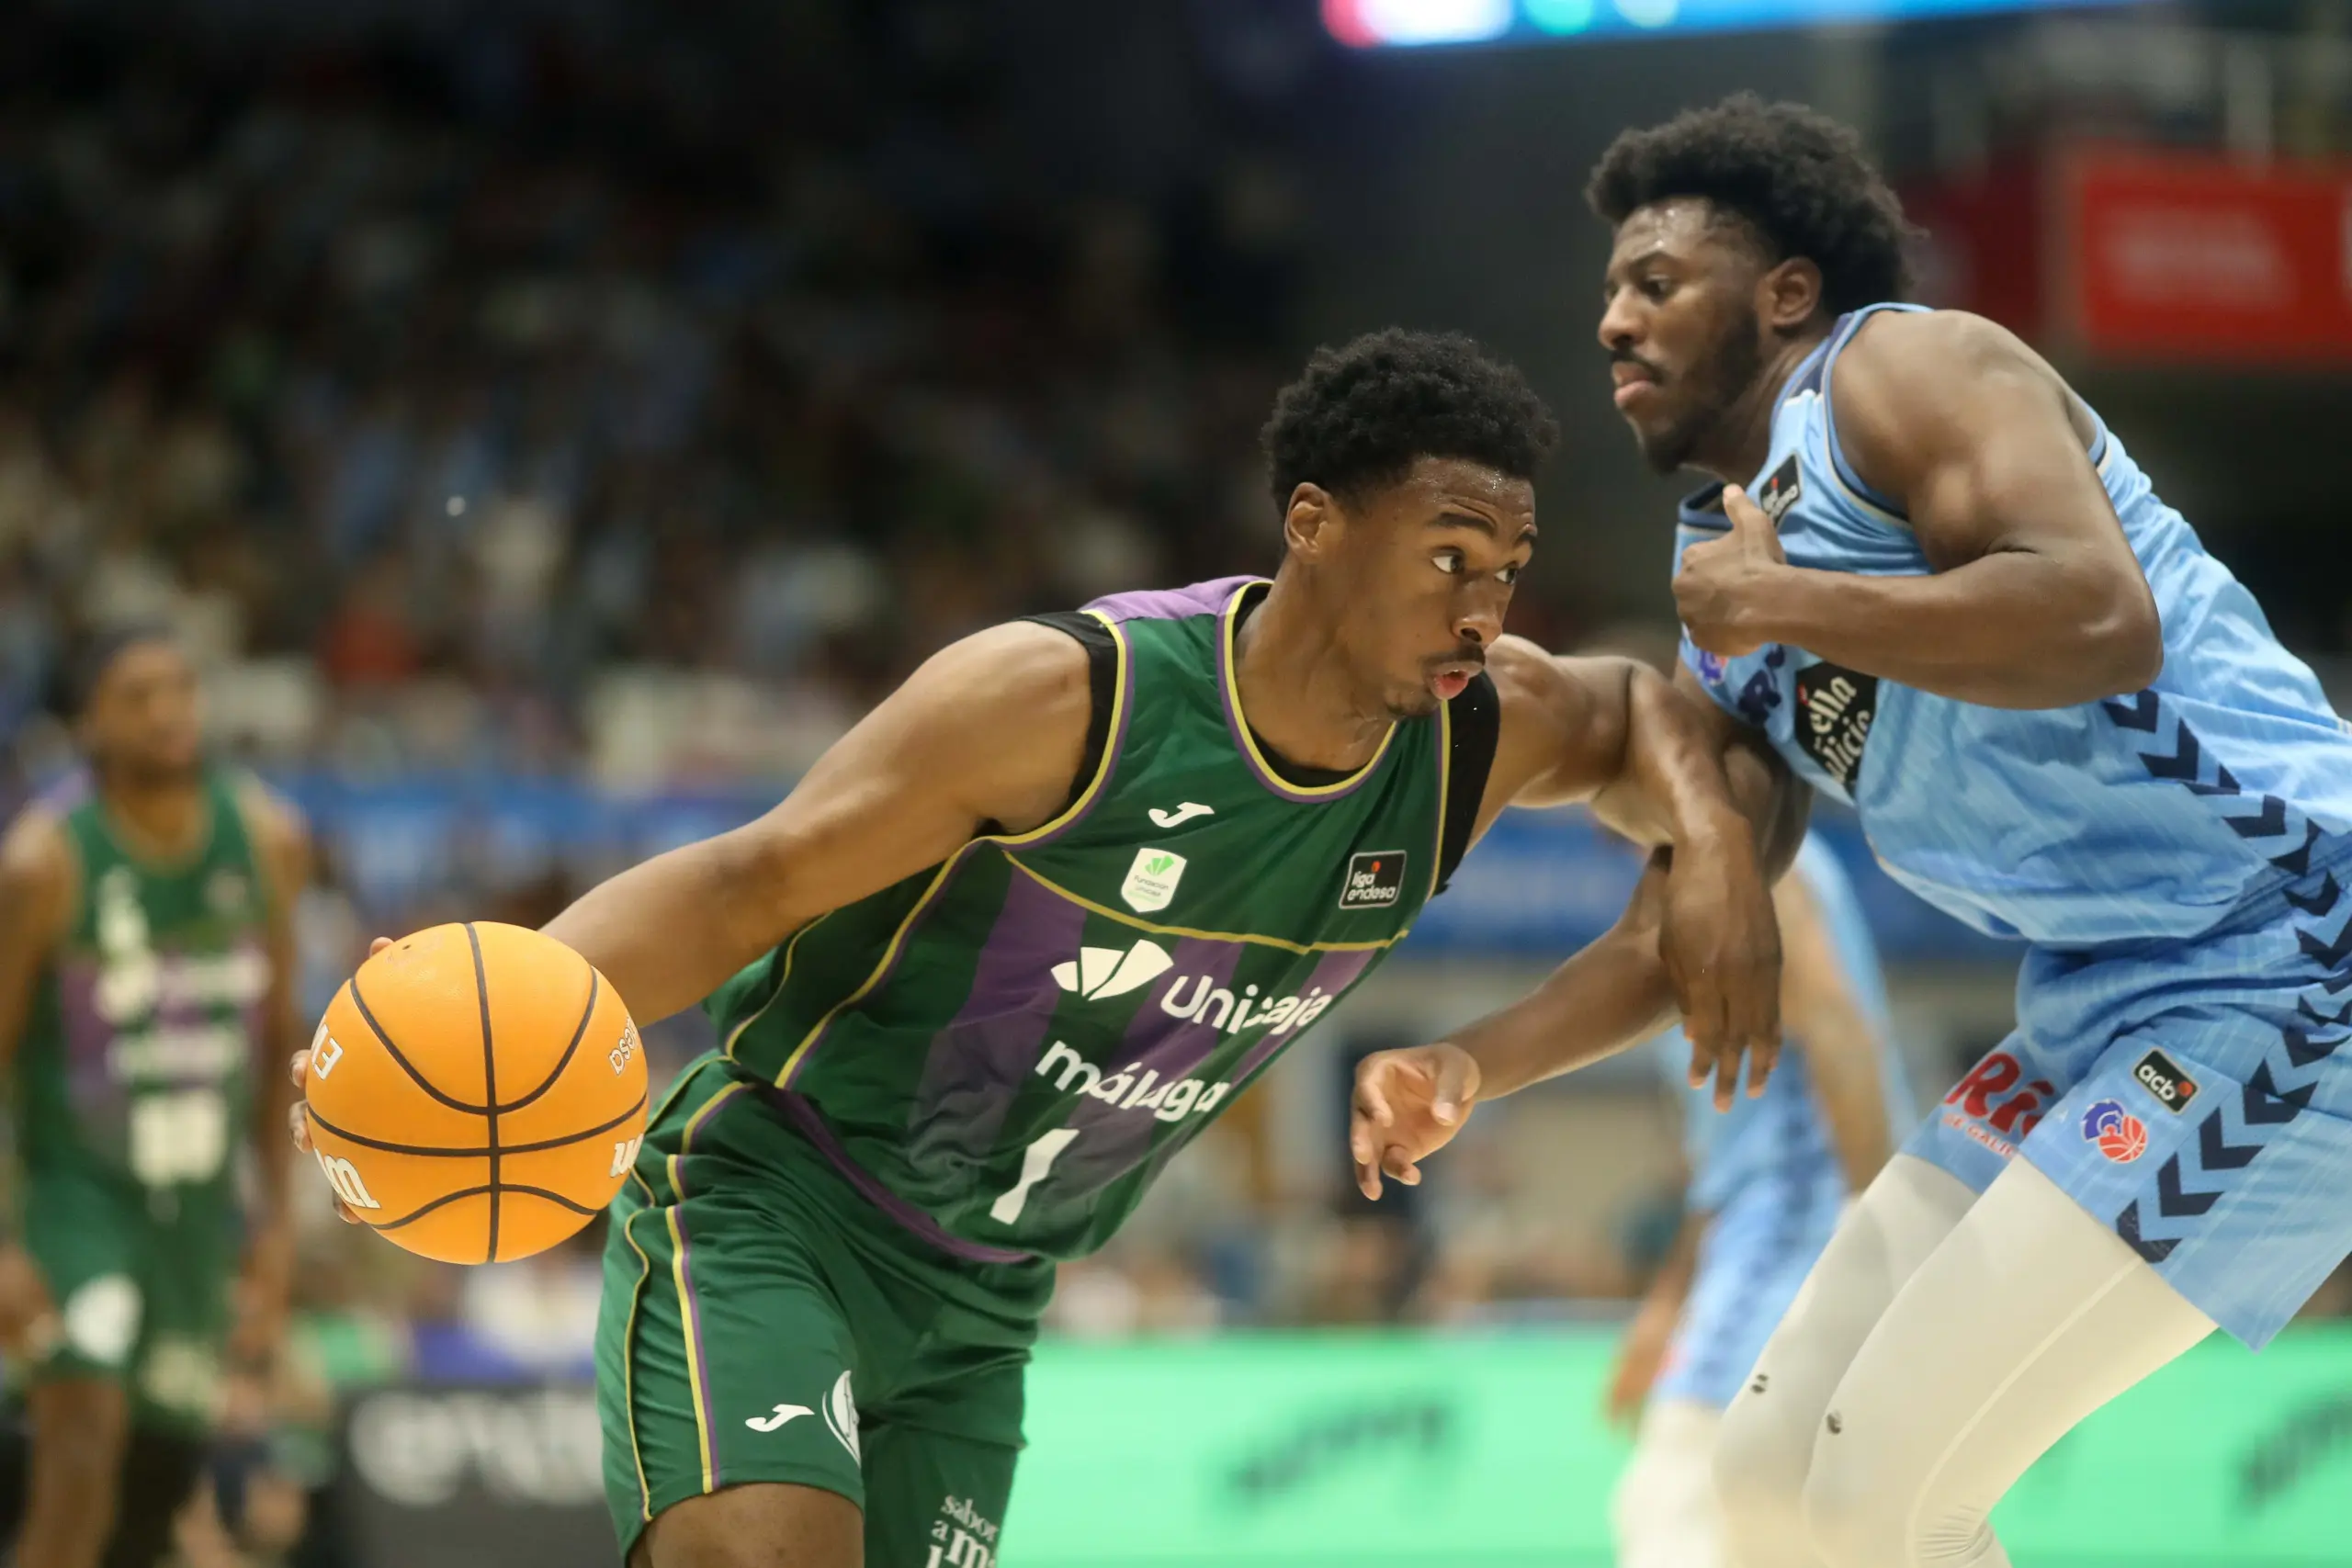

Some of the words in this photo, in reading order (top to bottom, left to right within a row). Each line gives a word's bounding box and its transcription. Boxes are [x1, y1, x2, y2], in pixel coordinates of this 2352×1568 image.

[1347, 885, 1396, 901] endesa
[1351, 870, 1376, 888] liga
[1159, 975, 1332, 1035] Unicaja
[1035, 1040, 1231, 1122] málaga
[2138, 1064, 2177, 1101] acb
[989, 1128, 1080, 1224] 1
